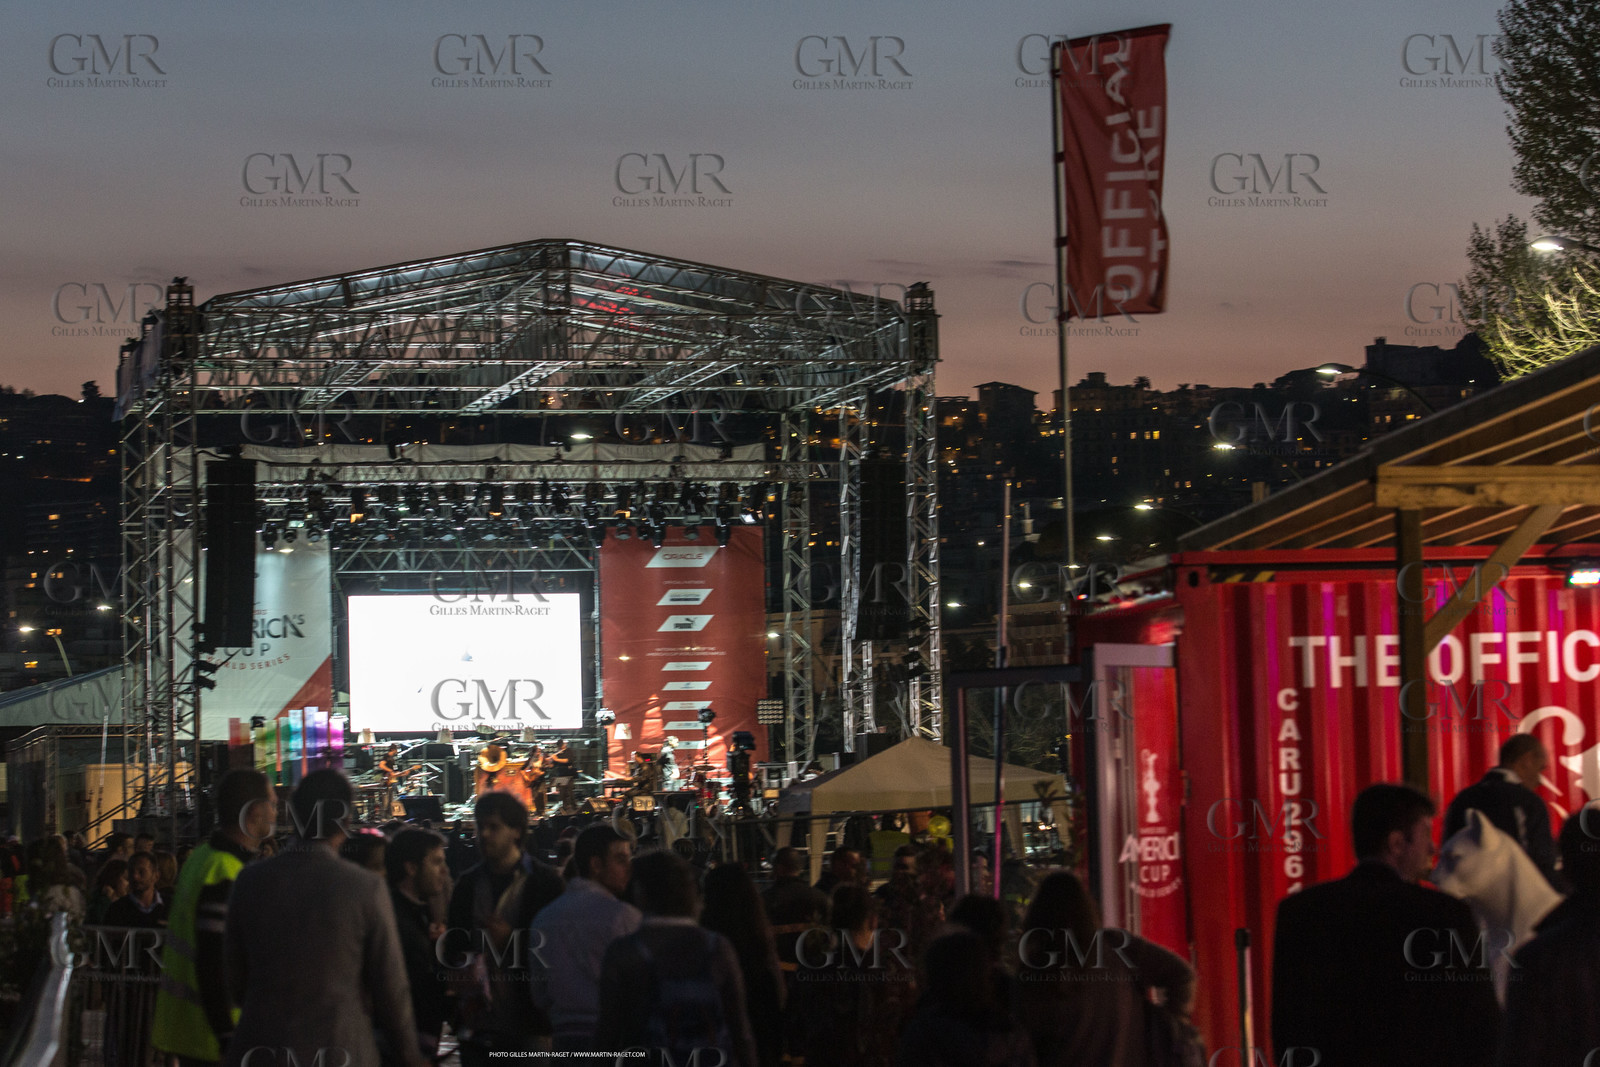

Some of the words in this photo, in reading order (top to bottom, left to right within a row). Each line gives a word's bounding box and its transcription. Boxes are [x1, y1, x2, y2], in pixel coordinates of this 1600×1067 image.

[1102, 37, 1146, 303] OFFICIAL
[662, 553, 704, 561] ORACLE
[250, 653, 291, 671] SERIES
[1288, 634, 1401, 689] THE
[1139, 864, 1171, 883] CUP
